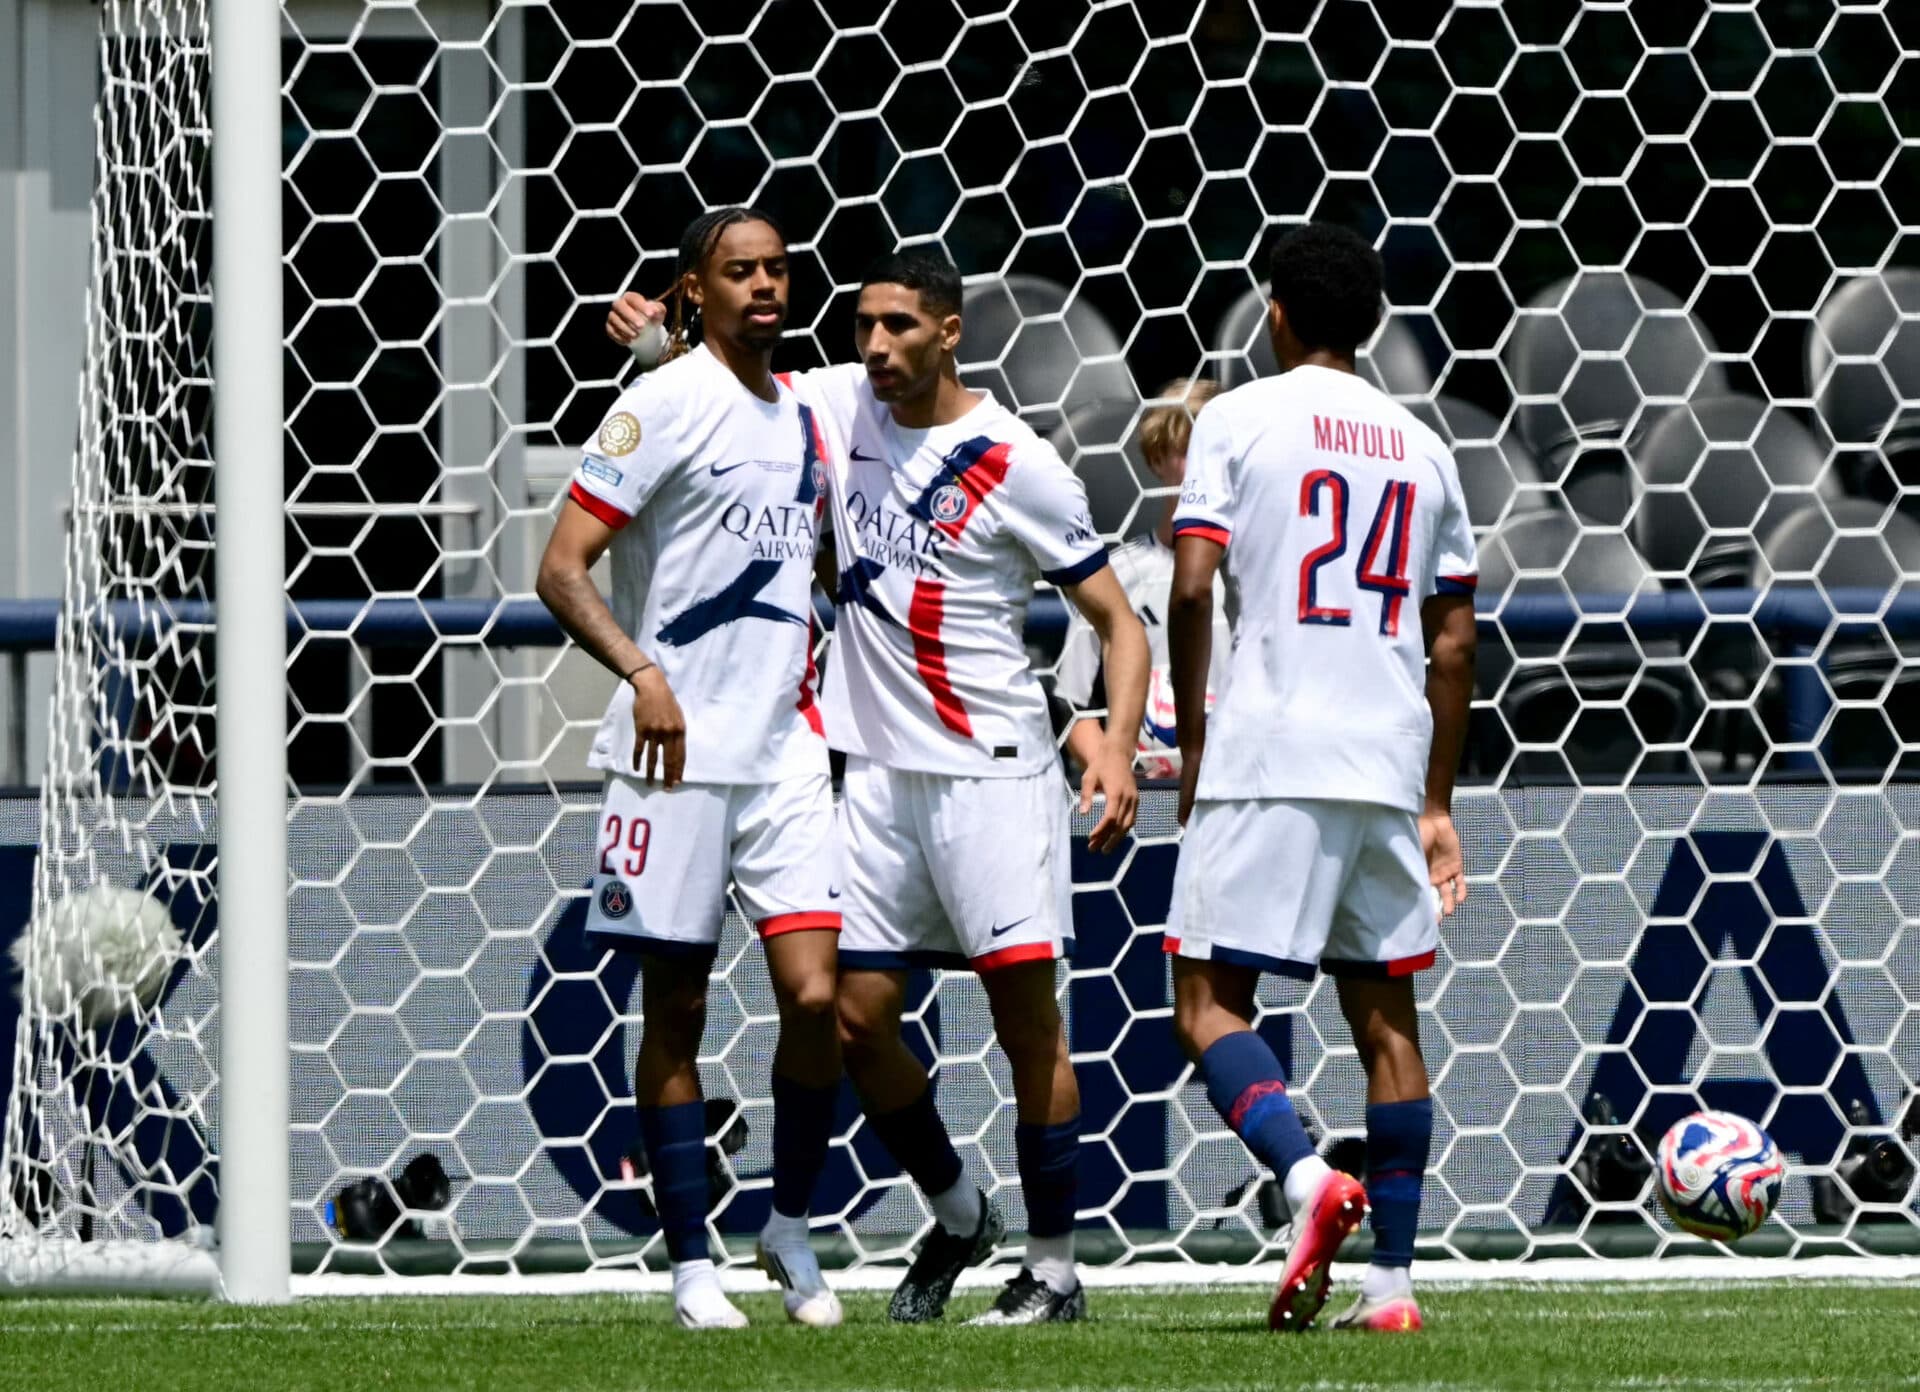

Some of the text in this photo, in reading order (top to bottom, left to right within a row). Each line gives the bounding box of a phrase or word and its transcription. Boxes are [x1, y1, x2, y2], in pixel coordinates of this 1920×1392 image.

[1312, 414, 1406, 462] MAYULU
[846, 491, 946, 561] QATAR
[862, 537, 942, 578] AIRWAYS
[1297, 468, 1417, 639] 24
[600, 814, 651, 877] 29
